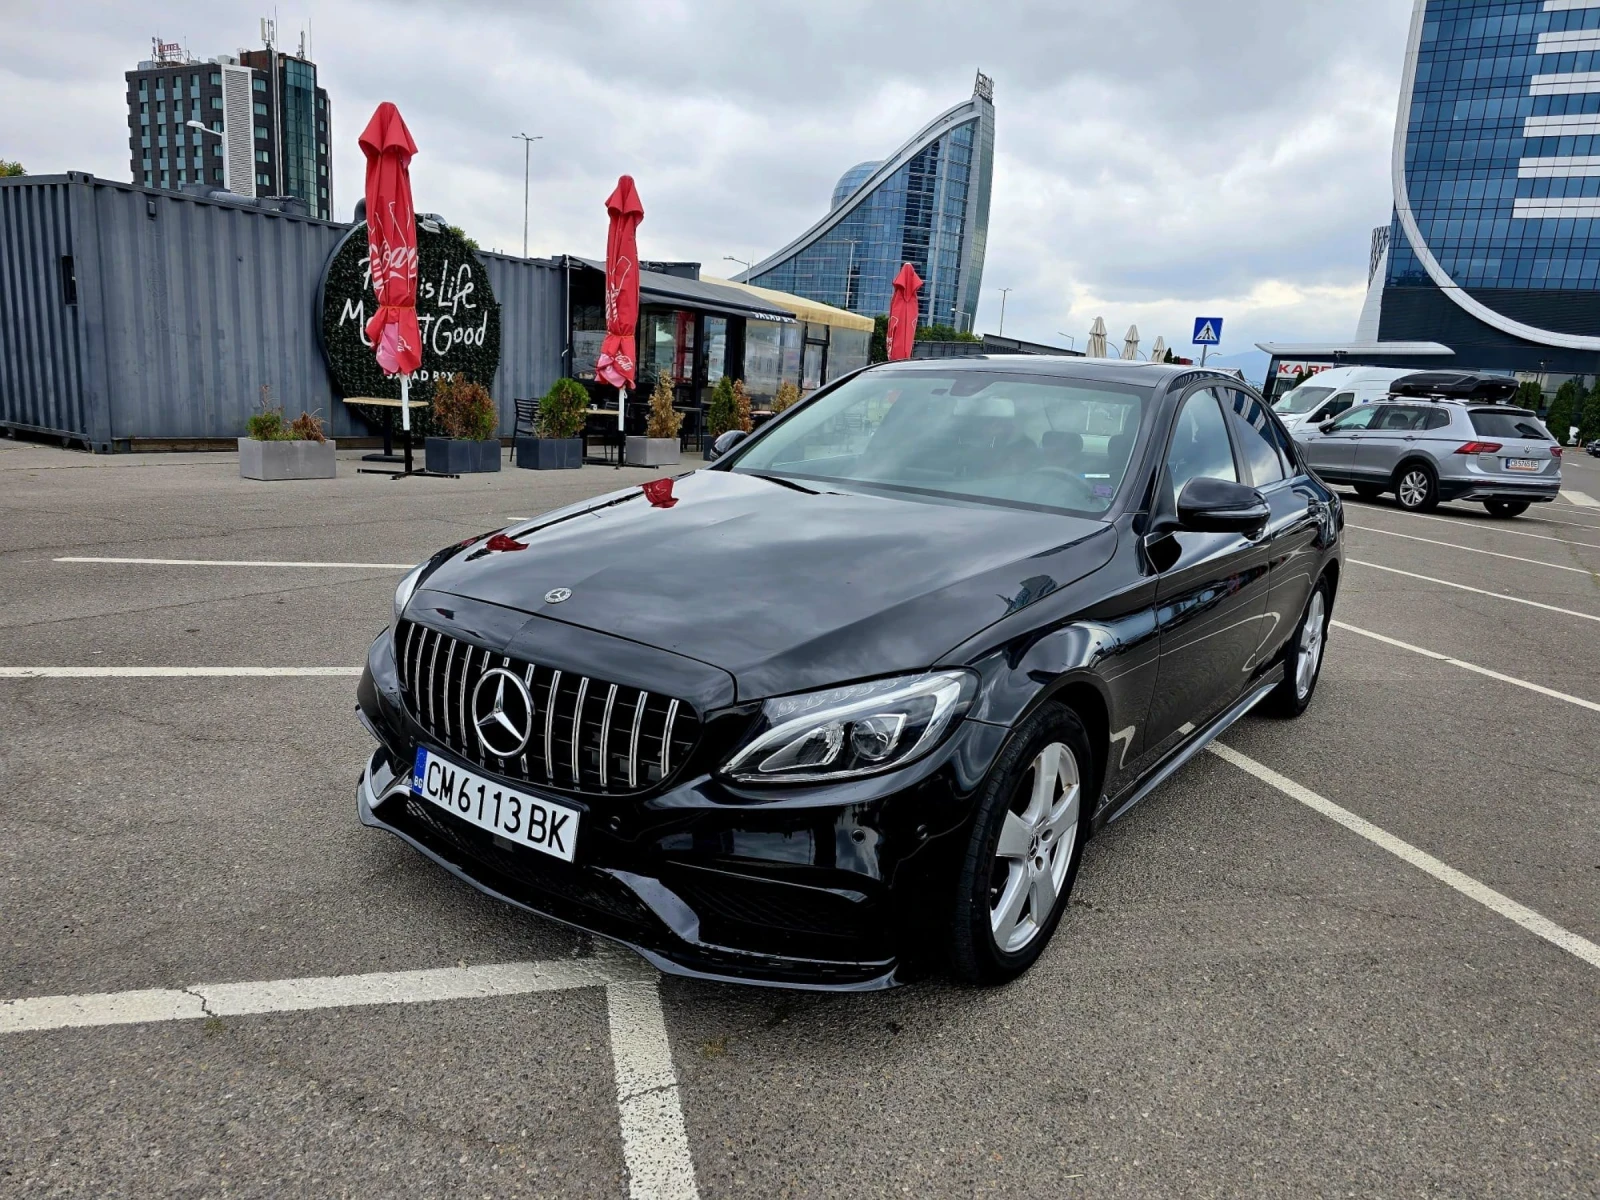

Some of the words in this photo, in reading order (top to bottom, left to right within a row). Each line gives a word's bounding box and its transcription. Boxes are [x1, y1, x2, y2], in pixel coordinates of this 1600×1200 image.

[419, 278, 435, 299] is
[438, 259, 477, 317] Life
[432, 310, 488, 356] Good
[413, 774, 424, 789] BG
